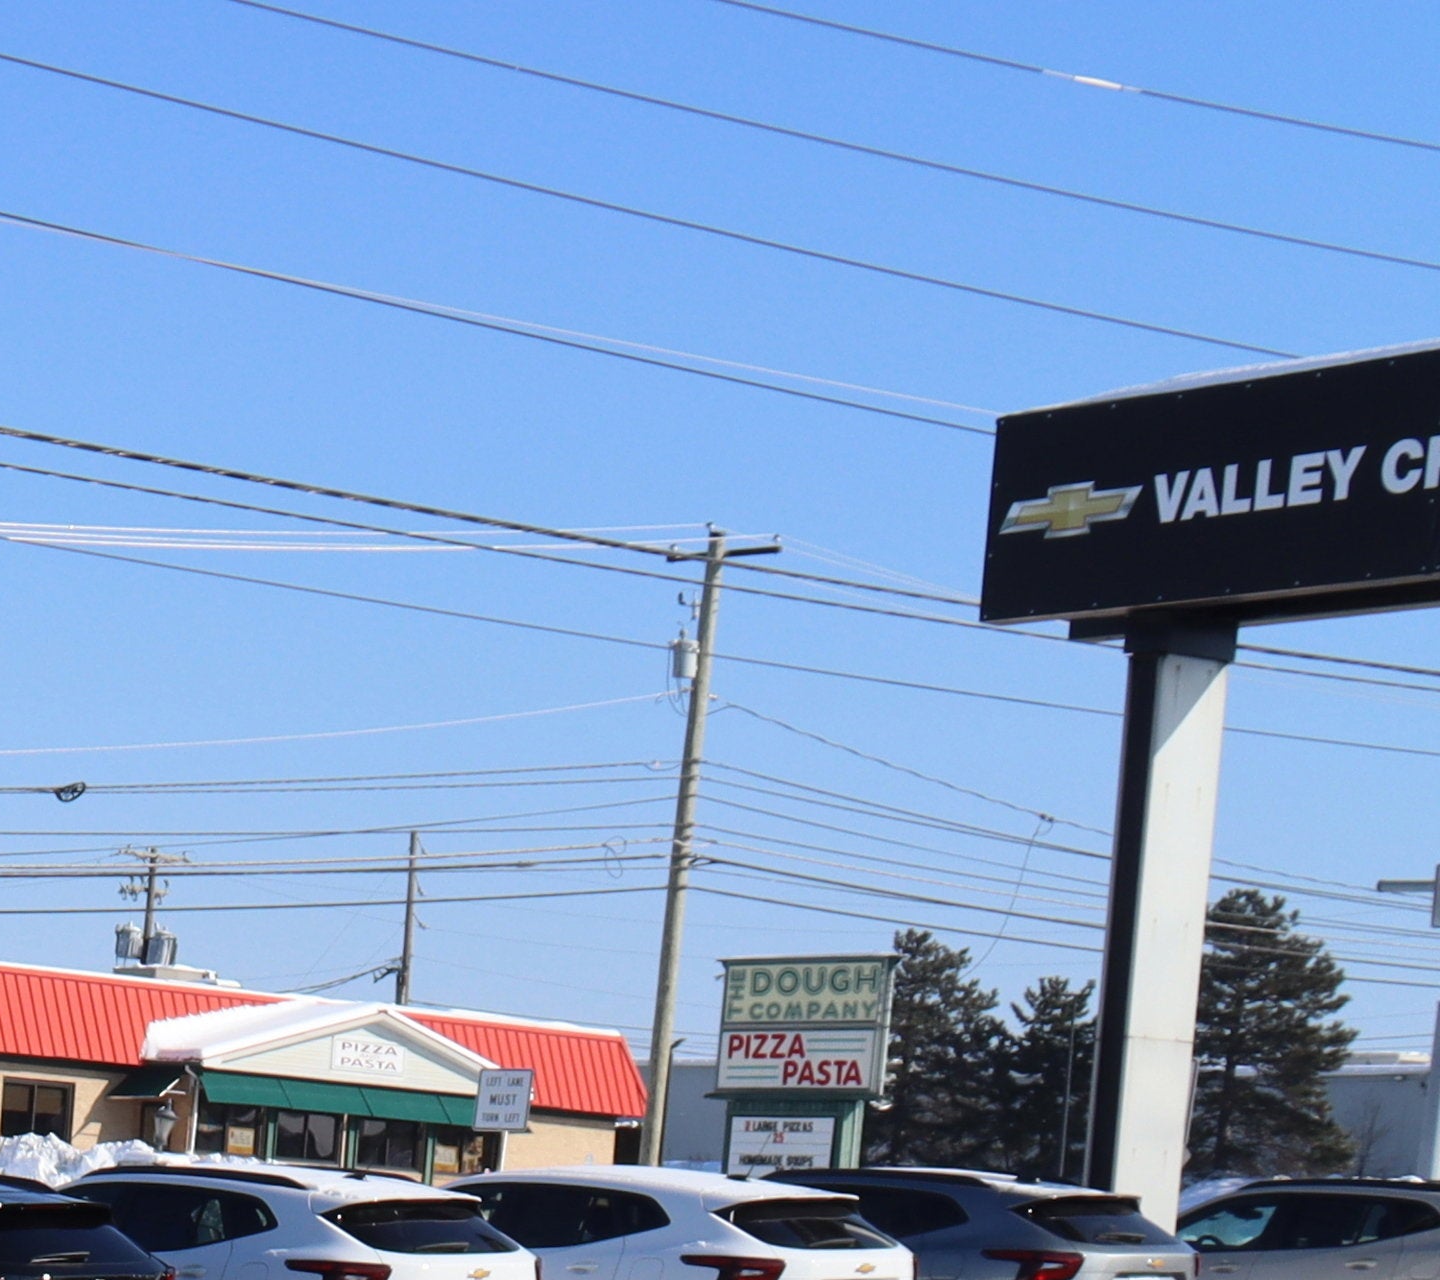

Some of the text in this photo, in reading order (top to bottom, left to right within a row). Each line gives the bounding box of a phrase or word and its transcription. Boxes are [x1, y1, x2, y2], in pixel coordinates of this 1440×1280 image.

[1154, 445, 1367, 523] VALLEY
[749, 964, 881, 997] DOUGH
[726, 968, 747, 1019] THE
[749, 1001, 877, 1020] COMPANY
[341, 1041, 397, 1056] PIZZA
[727, 1033, 806, 1060] PIZZA
[340, 1056, 397, 1071] PASTA
[782, 1060, 862, 1086] PASTA
[486, 1077, 524, 1087] LEFT LANE
[489, 1094, 517, 1106] MUST
[482, 1112, 520, 1123] TURN LEFT
